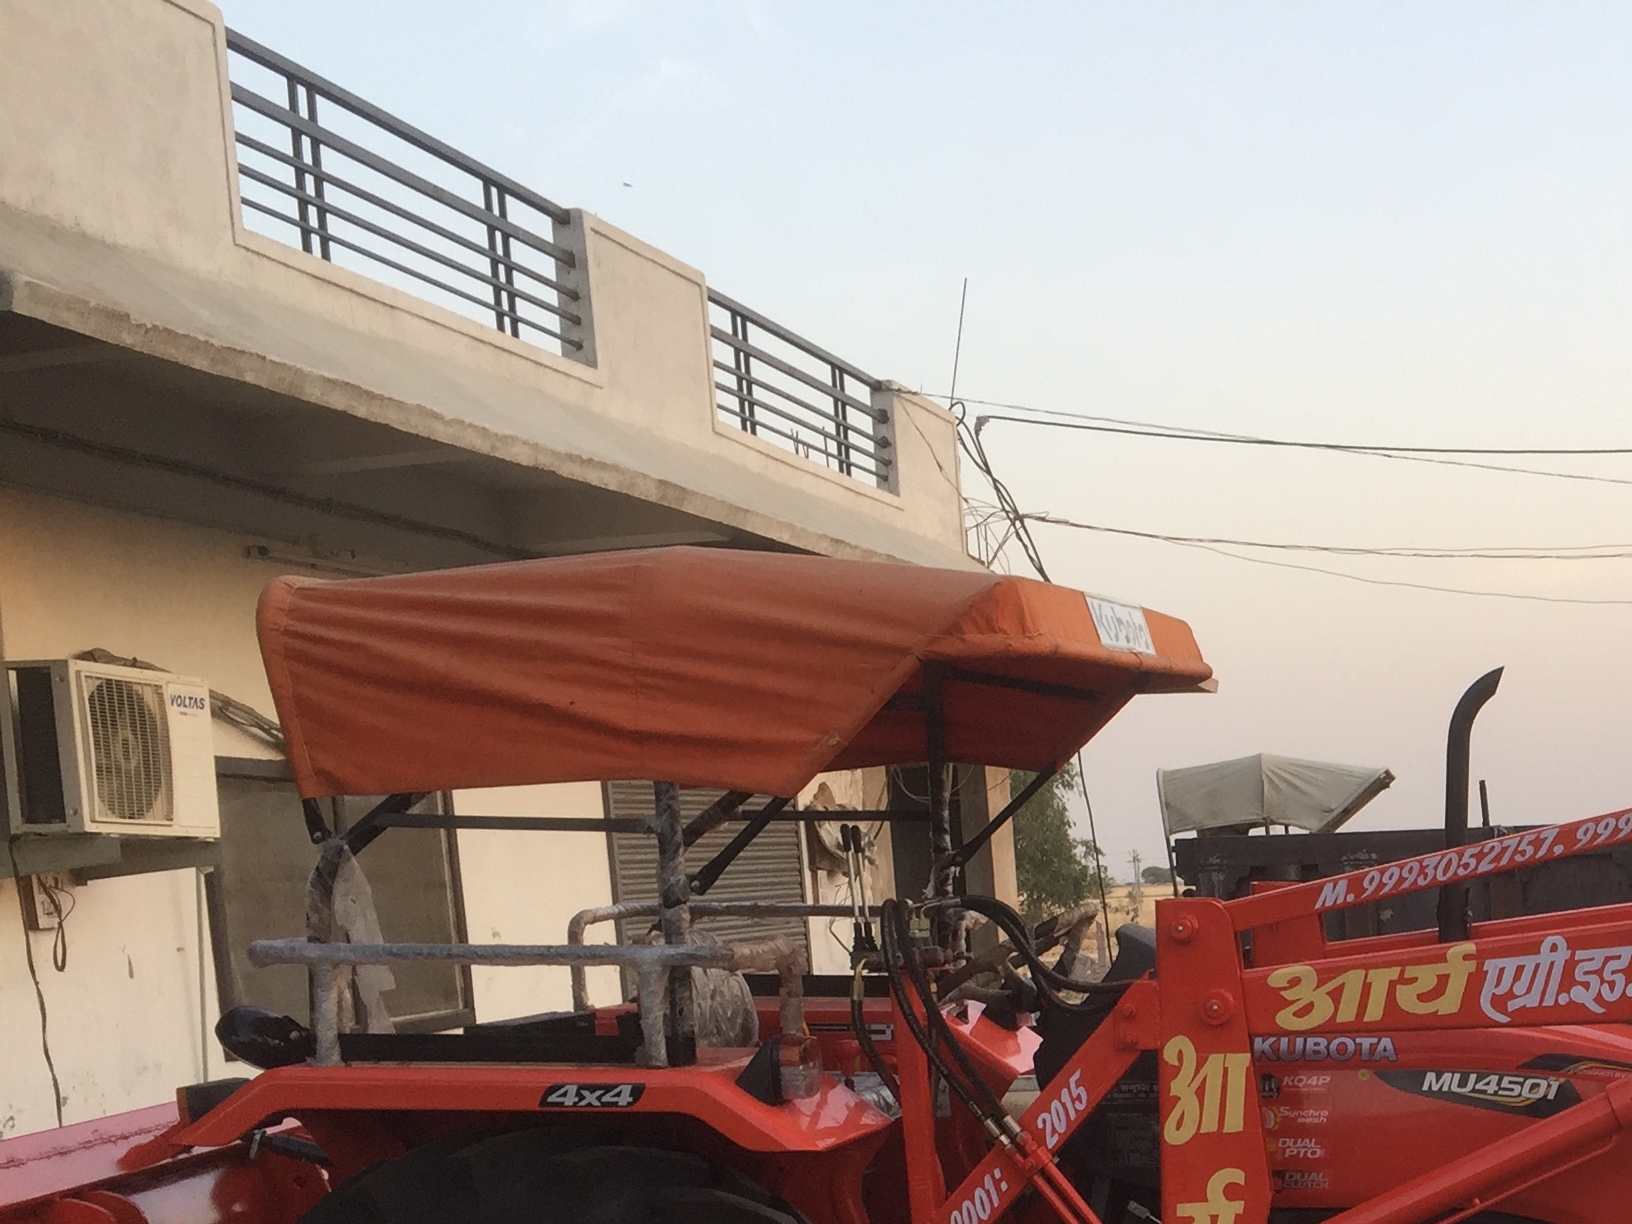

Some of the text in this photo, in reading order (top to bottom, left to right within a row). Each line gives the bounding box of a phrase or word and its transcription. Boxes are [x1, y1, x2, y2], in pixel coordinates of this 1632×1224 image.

[170, 694, 206, 710] VOLTAS
[1268, 943, 1476, 1031] आर्य
[1253, 1036, 1398, 1062] KUBOTA
[546, 1084, 634, 1107] 4x4
[1422, 1072, 1561, 1100] MU4501
[1036, 1068, 1088, 1150] 2015
[1278, 1137, 1321, 1149] DUAL
[1284, 1171, 1329, 1182] DUAL
